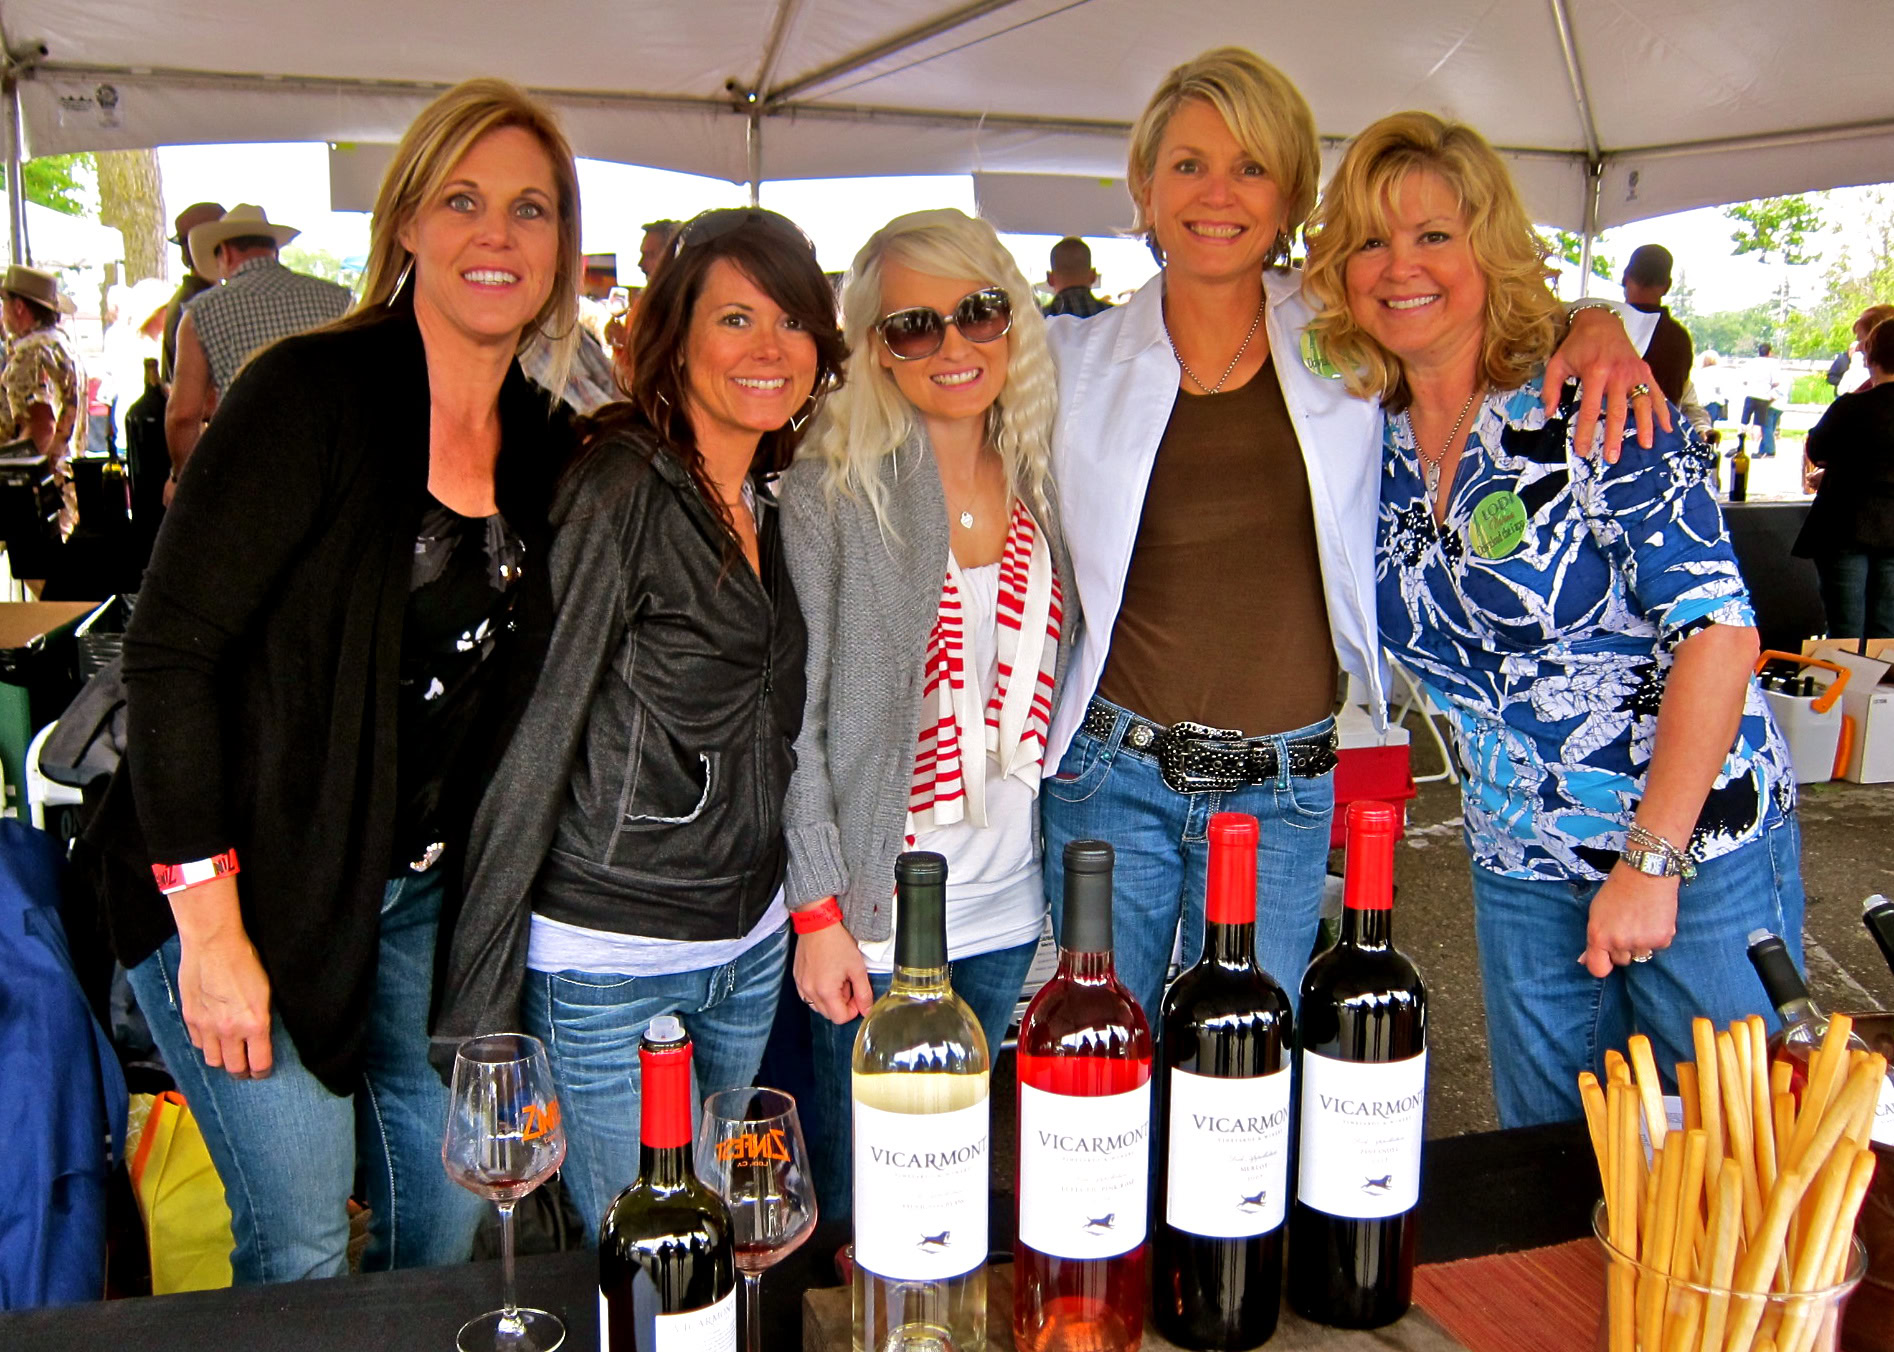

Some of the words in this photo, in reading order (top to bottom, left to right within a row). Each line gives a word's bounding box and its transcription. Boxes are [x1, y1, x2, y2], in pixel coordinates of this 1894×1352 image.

[1481, 492, 1515, 520] LODI
[1192, 1104, 1289, 1134] VICARMON
[1319, 1087, 1424, 1119] VICARMONT
[870, 1135, 987, 1171] VICARMONT
[1038, 1120, 1148, 1155] VICARMONT
